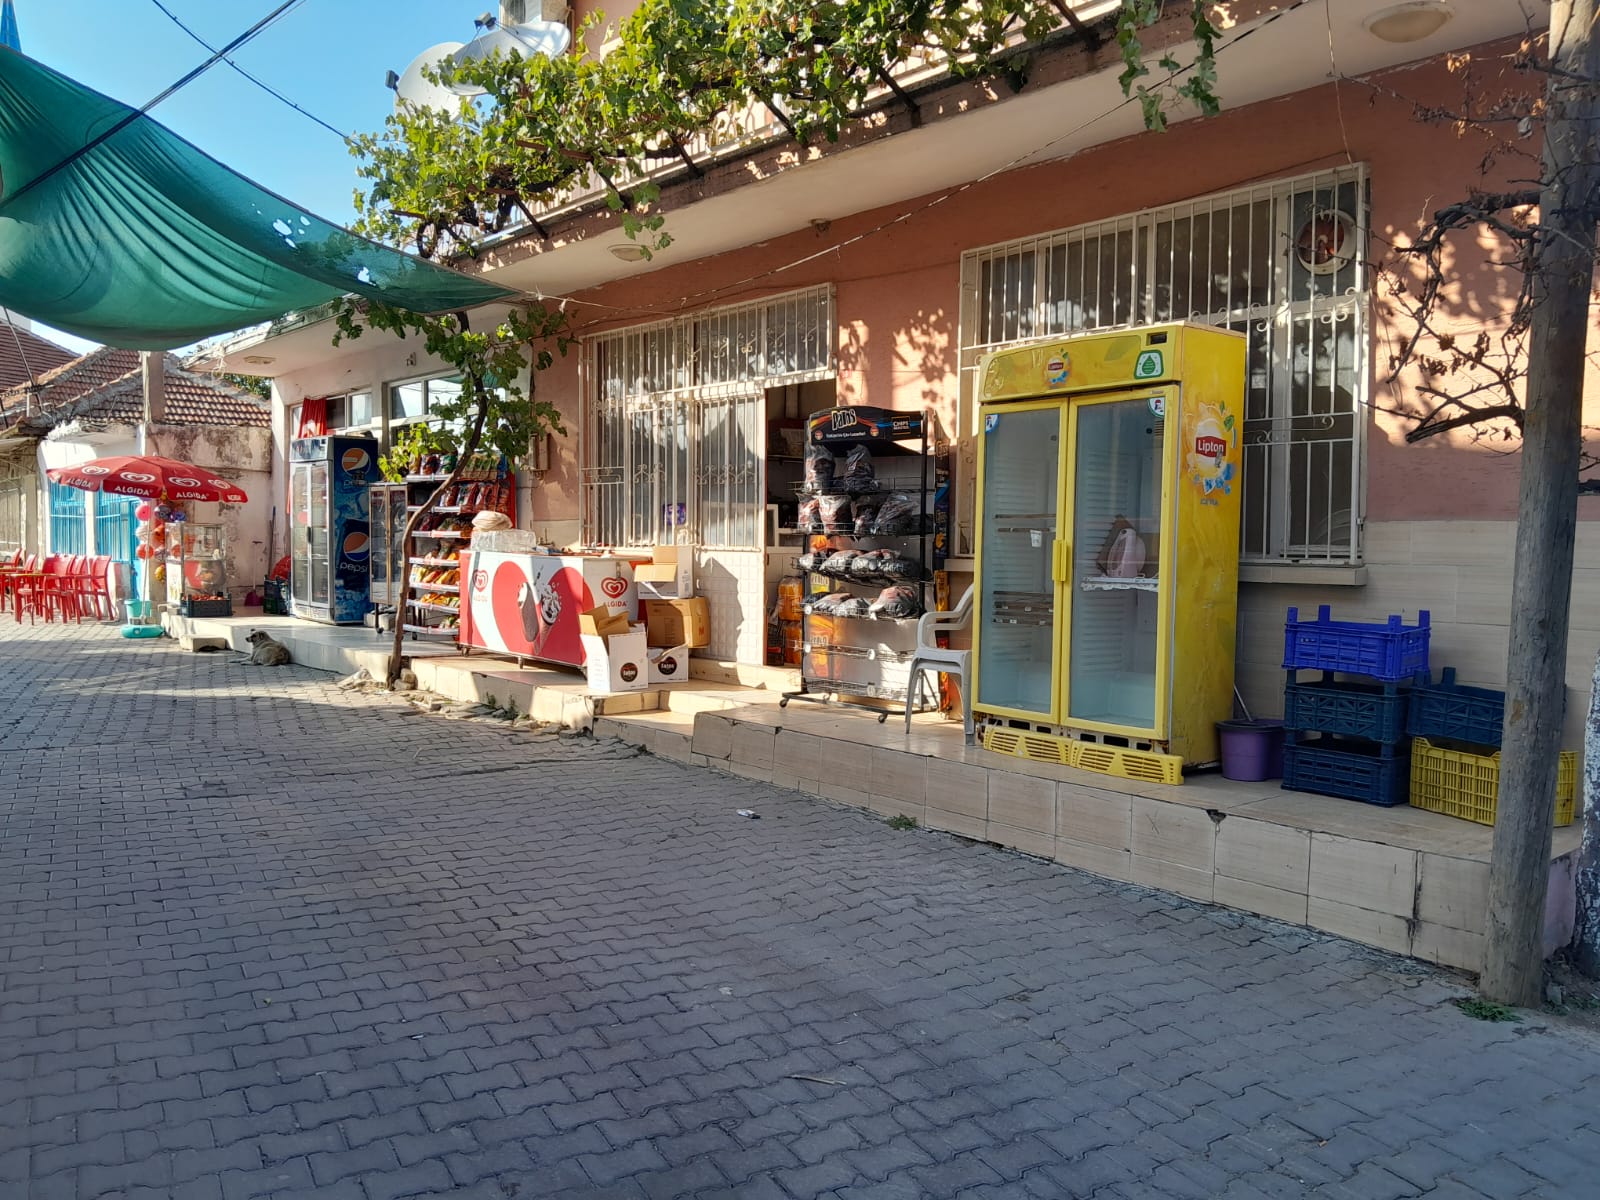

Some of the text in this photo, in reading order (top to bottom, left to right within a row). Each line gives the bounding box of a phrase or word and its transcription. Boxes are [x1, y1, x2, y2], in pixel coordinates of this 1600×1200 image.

[1197, 439, 1224, 454] Lipton
[67, 479, 92, 489] ALGIDA
[114, 485, 150, 496] ALGIDA
[176, 491, 208, 500] ALGIDA
[340, 562, 368, 573] pepsi
